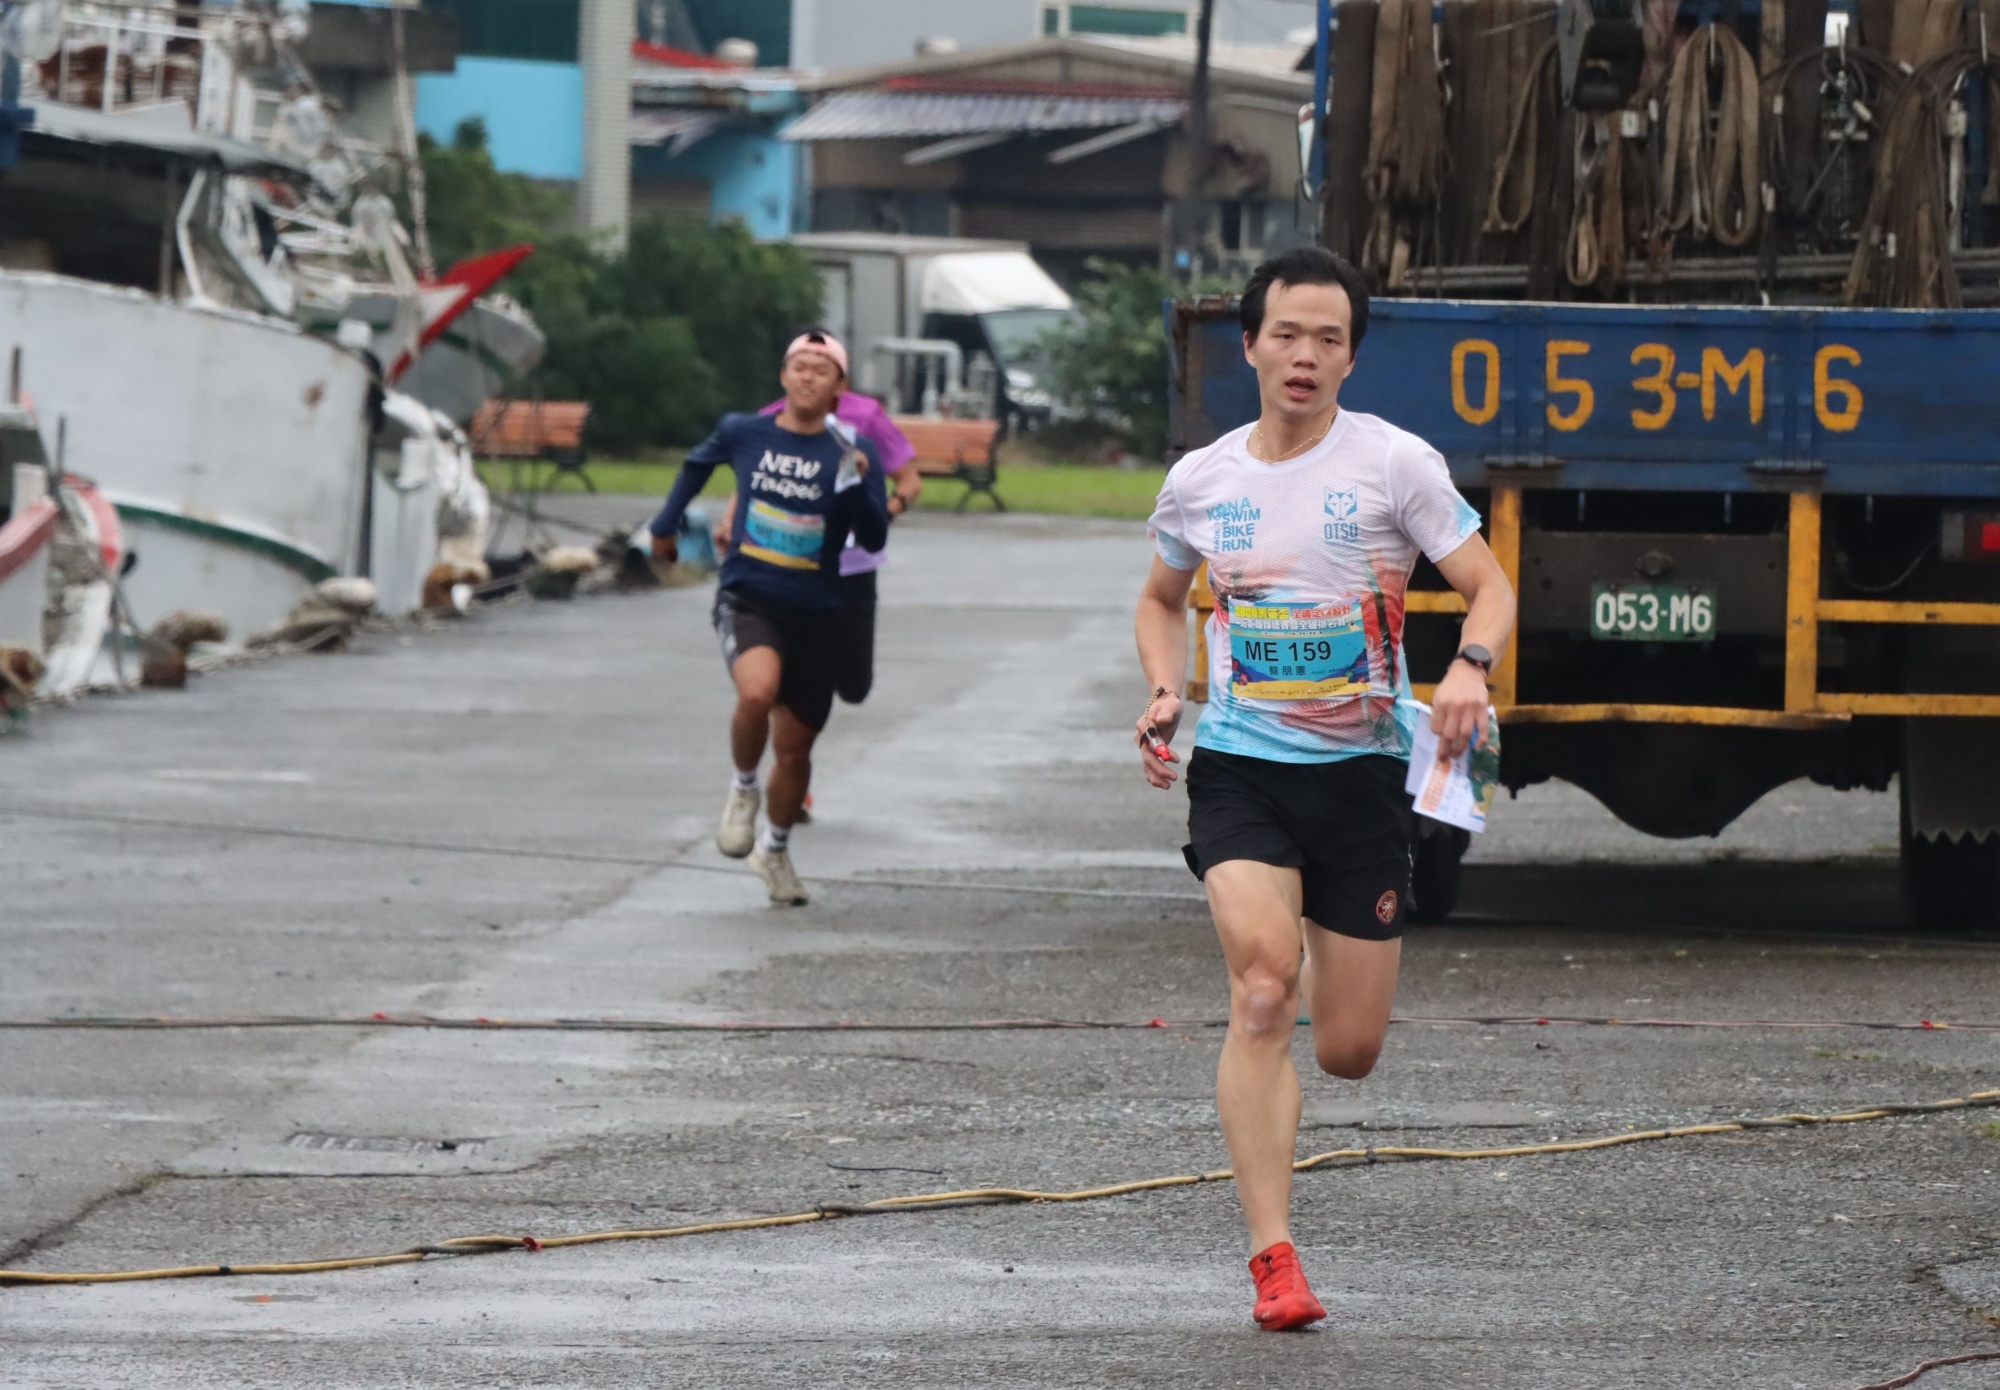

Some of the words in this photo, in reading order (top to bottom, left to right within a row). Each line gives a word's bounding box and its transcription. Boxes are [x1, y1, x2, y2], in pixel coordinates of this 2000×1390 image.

[757, 449, 821, 480] NEW
[1222, 508, 1261, 525] SWIM
[1222, 523, 1255, 538] BIKE
[1324, 522, 1359, 540] OTSO
[1222, 538, 1253, 552] RUN
[1595, 593, 1712, 633] 053-M6
[1245, 640, 1279, 662] ME
[1288, 640, 1332, 662] 159
